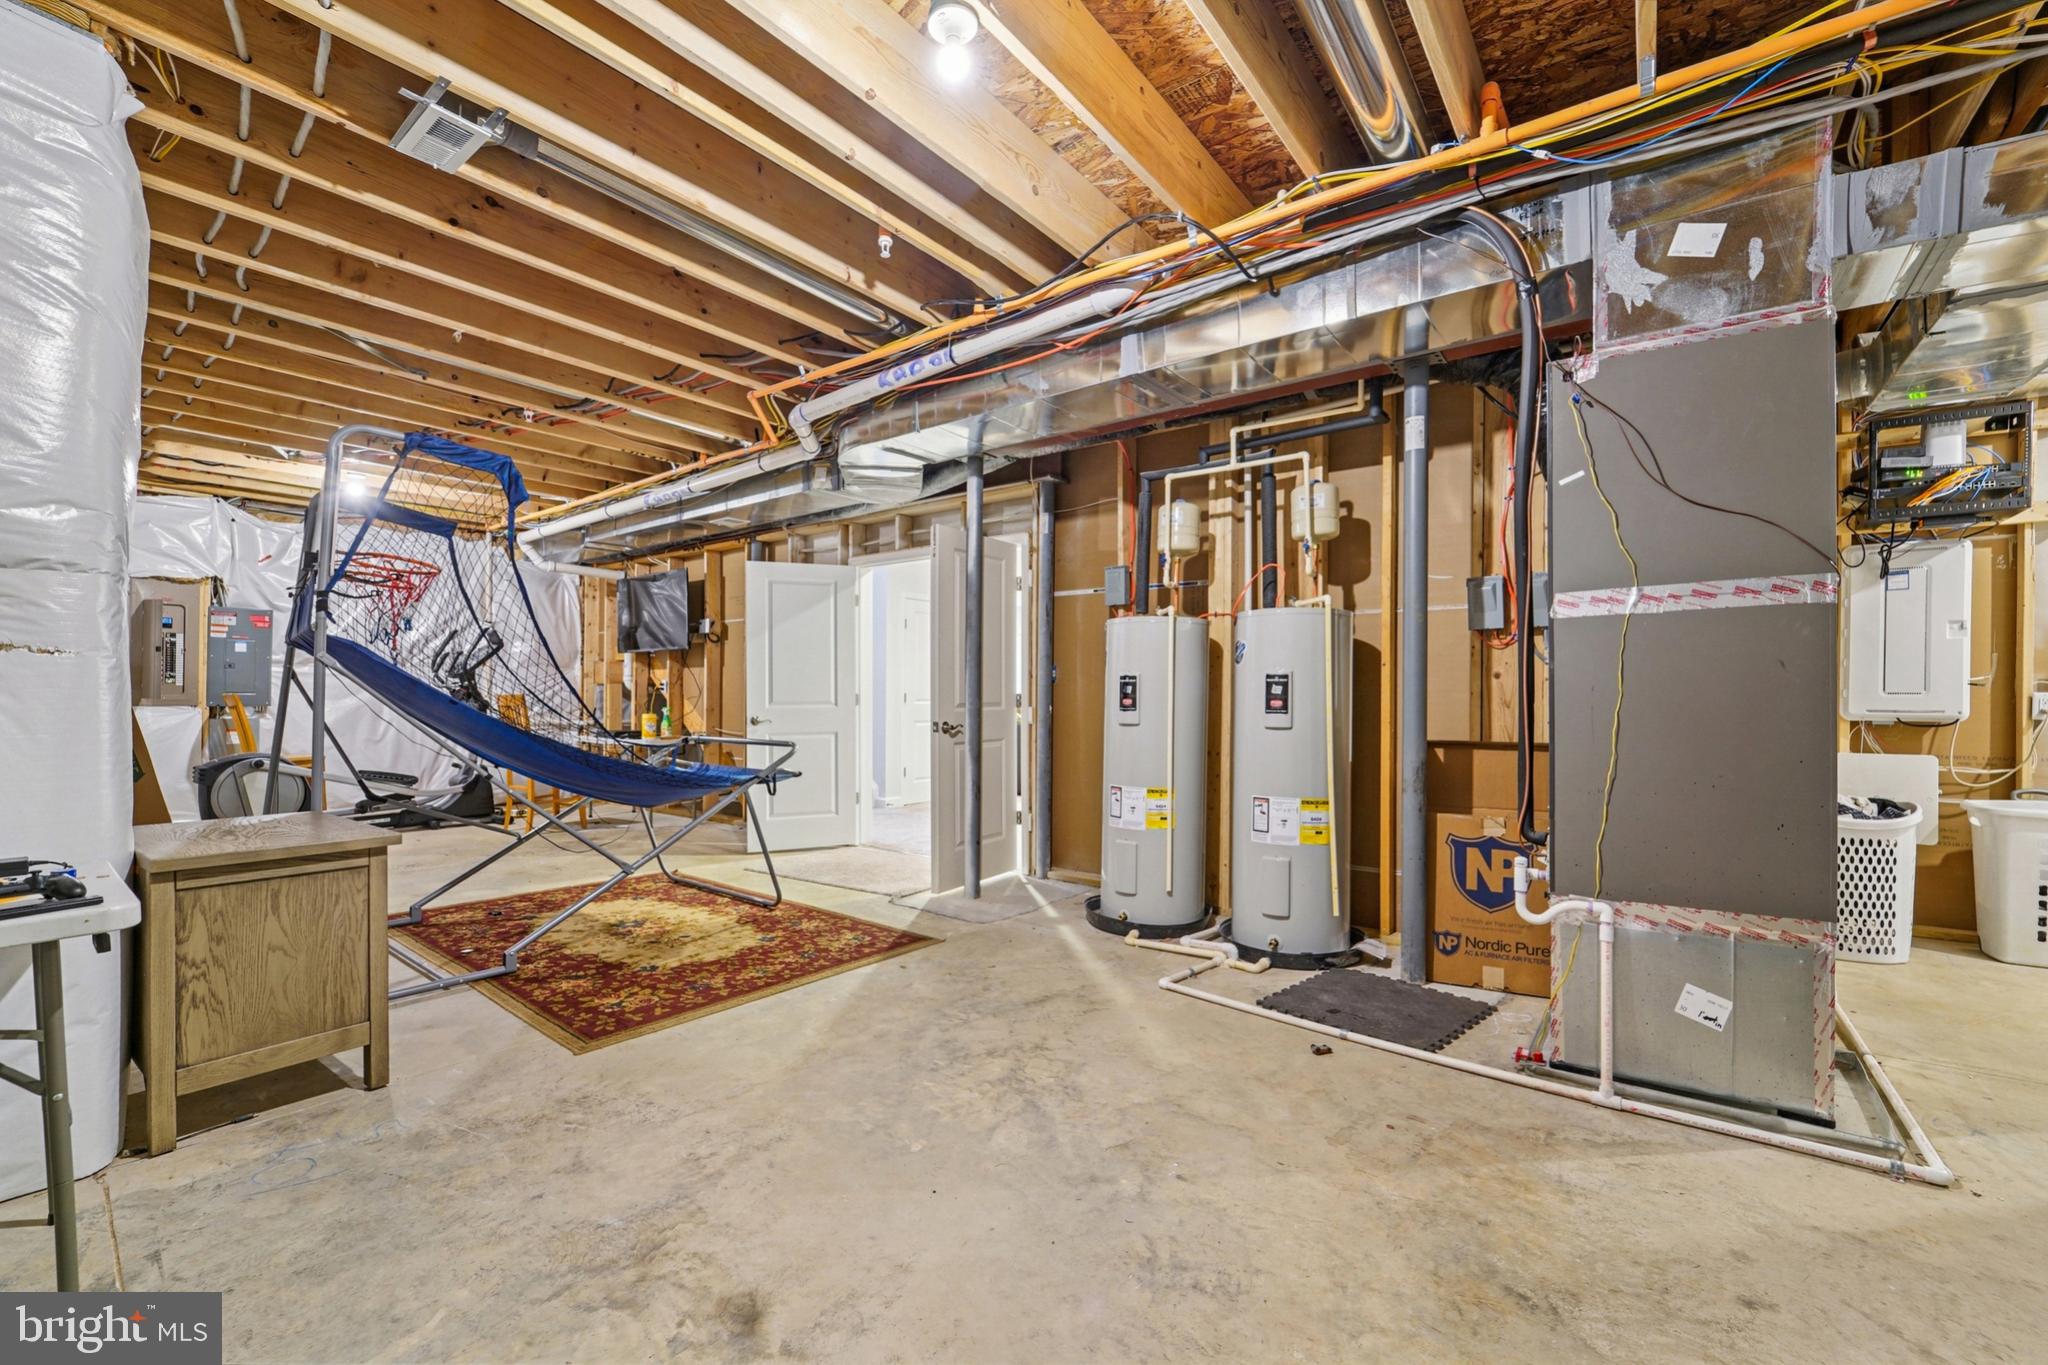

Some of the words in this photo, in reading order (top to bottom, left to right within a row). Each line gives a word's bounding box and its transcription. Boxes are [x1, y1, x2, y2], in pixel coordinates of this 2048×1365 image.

[1466, 847, 1518, 893] NP
[1439, 934, 1458, 951] NP
[1465, 936, 1512, 953] Nordic
[1515, 942, 1551, 958] Pure
